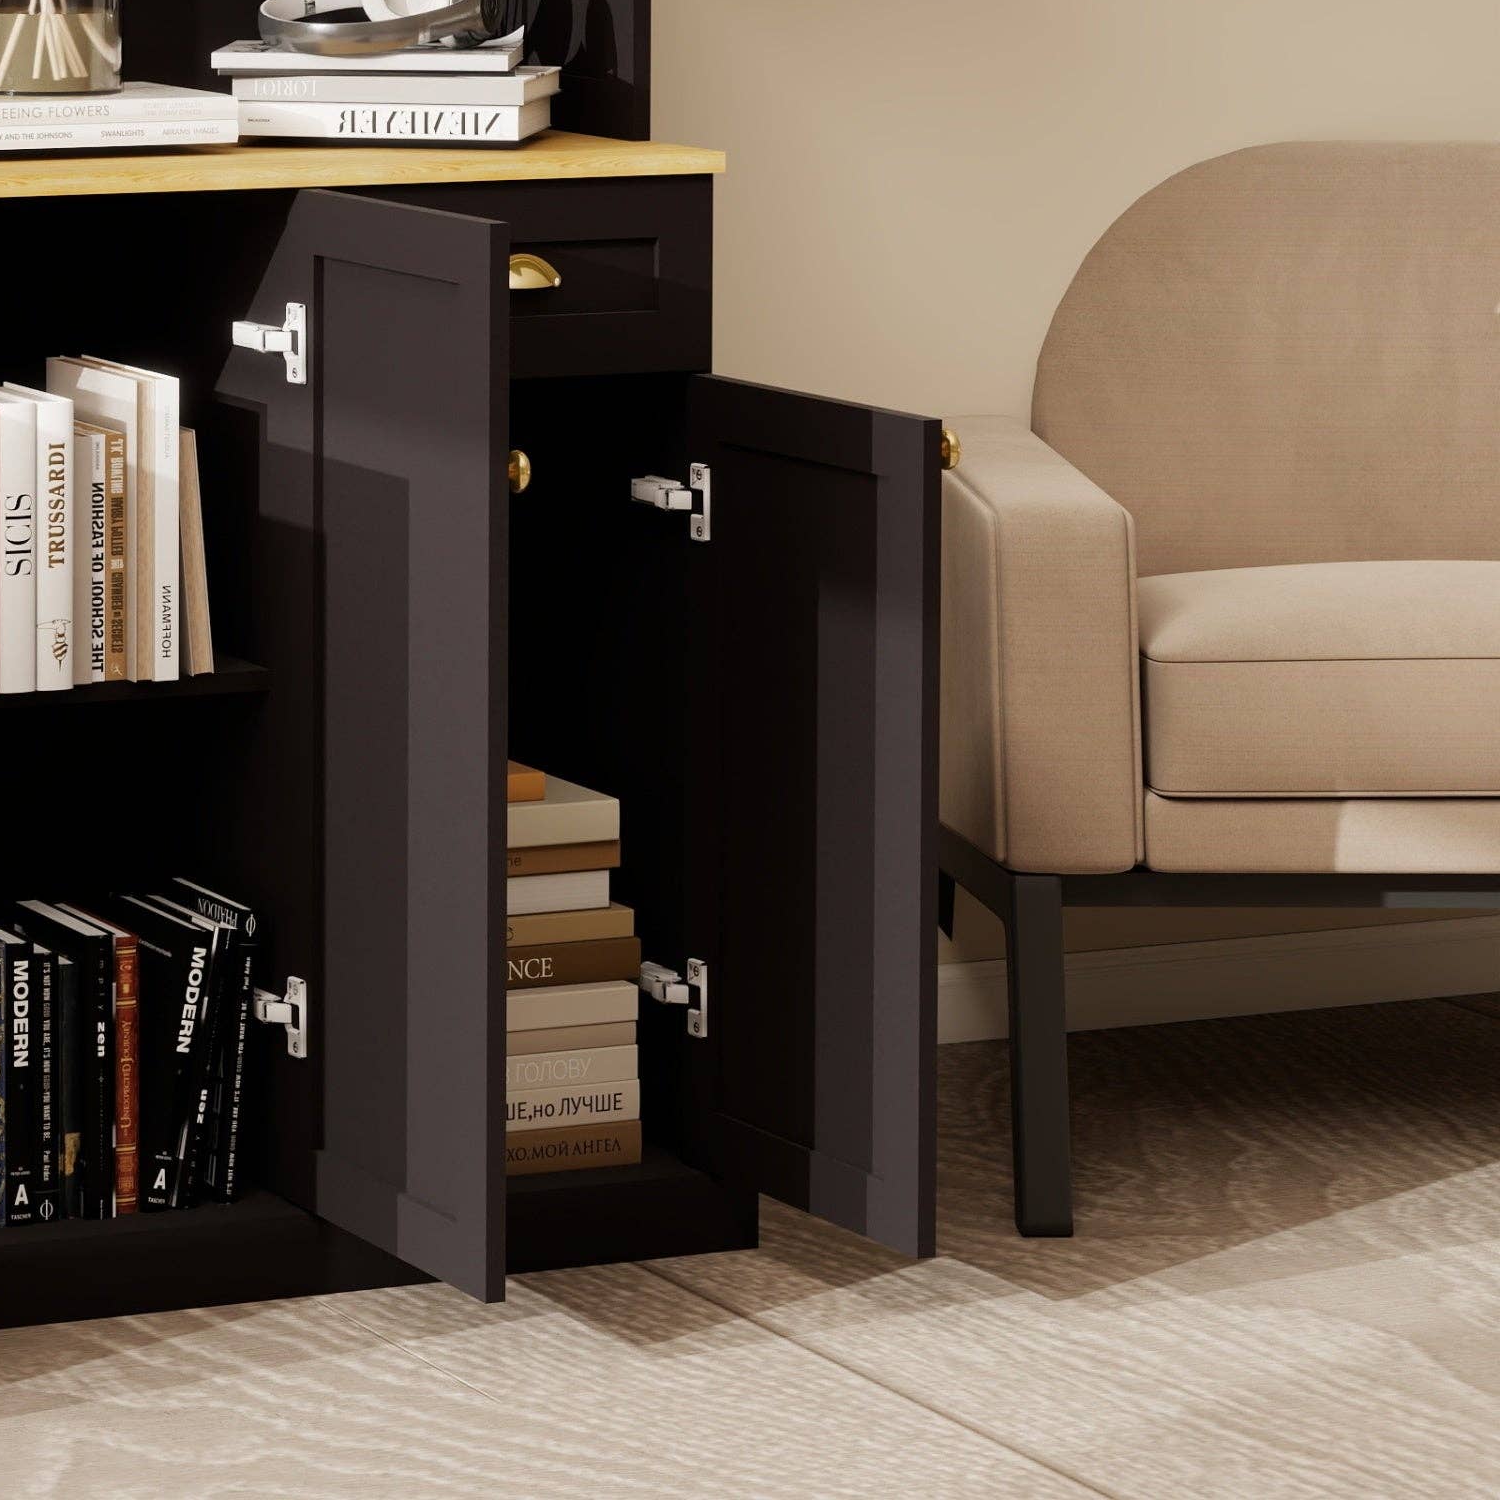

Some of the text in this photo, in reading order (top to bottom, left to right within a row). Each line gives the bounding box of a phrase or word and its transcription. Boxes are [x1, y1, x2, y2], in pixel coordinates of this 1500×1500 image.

[47, 103, 111, 119] FLOWERS
[3, 131, 20, 141] AND
[20, 130, 35, 140] THE
[35, 129, 73, 140] JOHNSONS
[100, 127, 145, 138] SWANLIGHTS
[47, 442, 66, 569] TRUSSARDI
[4, 493, 34, 578] SICIS
[13, 959, 29, 1068] MODERN
[176, 946, 207, 1054] MODERN
[97, 1021, 106, 1058] zen
[516, 1057, 592, 1083] ГОЛОВУ
[196, 1089, 208, 1125] zen
[14, 1183, 29, 1206] A
[153, 1168, 167, 1190] A
